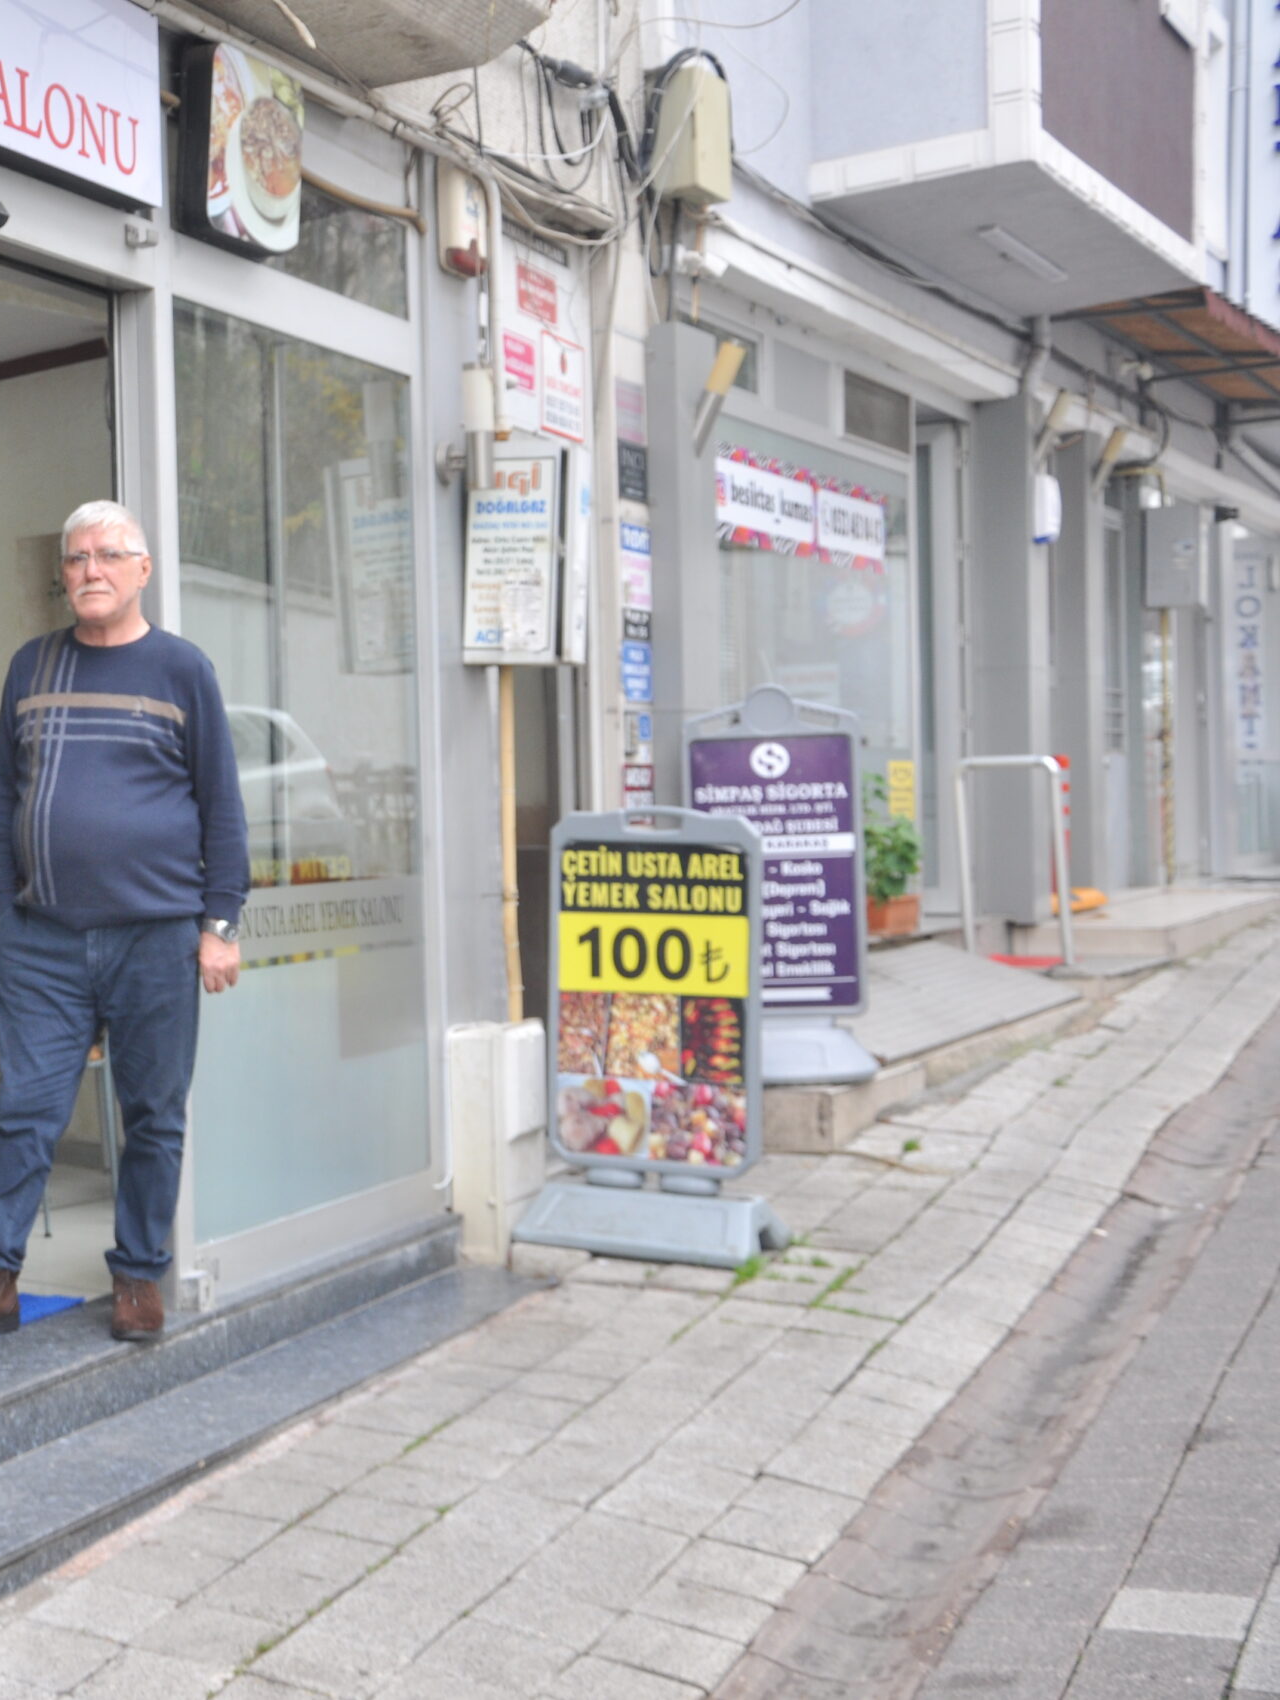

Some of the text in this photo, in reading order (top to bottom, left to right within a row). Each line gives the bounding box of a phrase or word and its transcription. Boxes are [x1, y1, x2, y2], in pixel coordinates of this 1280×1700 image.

[765, 780, 848, 801] SİGORTA
[561, 845, 744, 883] ÇETİN USTA AREL
[562, 879, 743, 913] YEMEK SALONU
